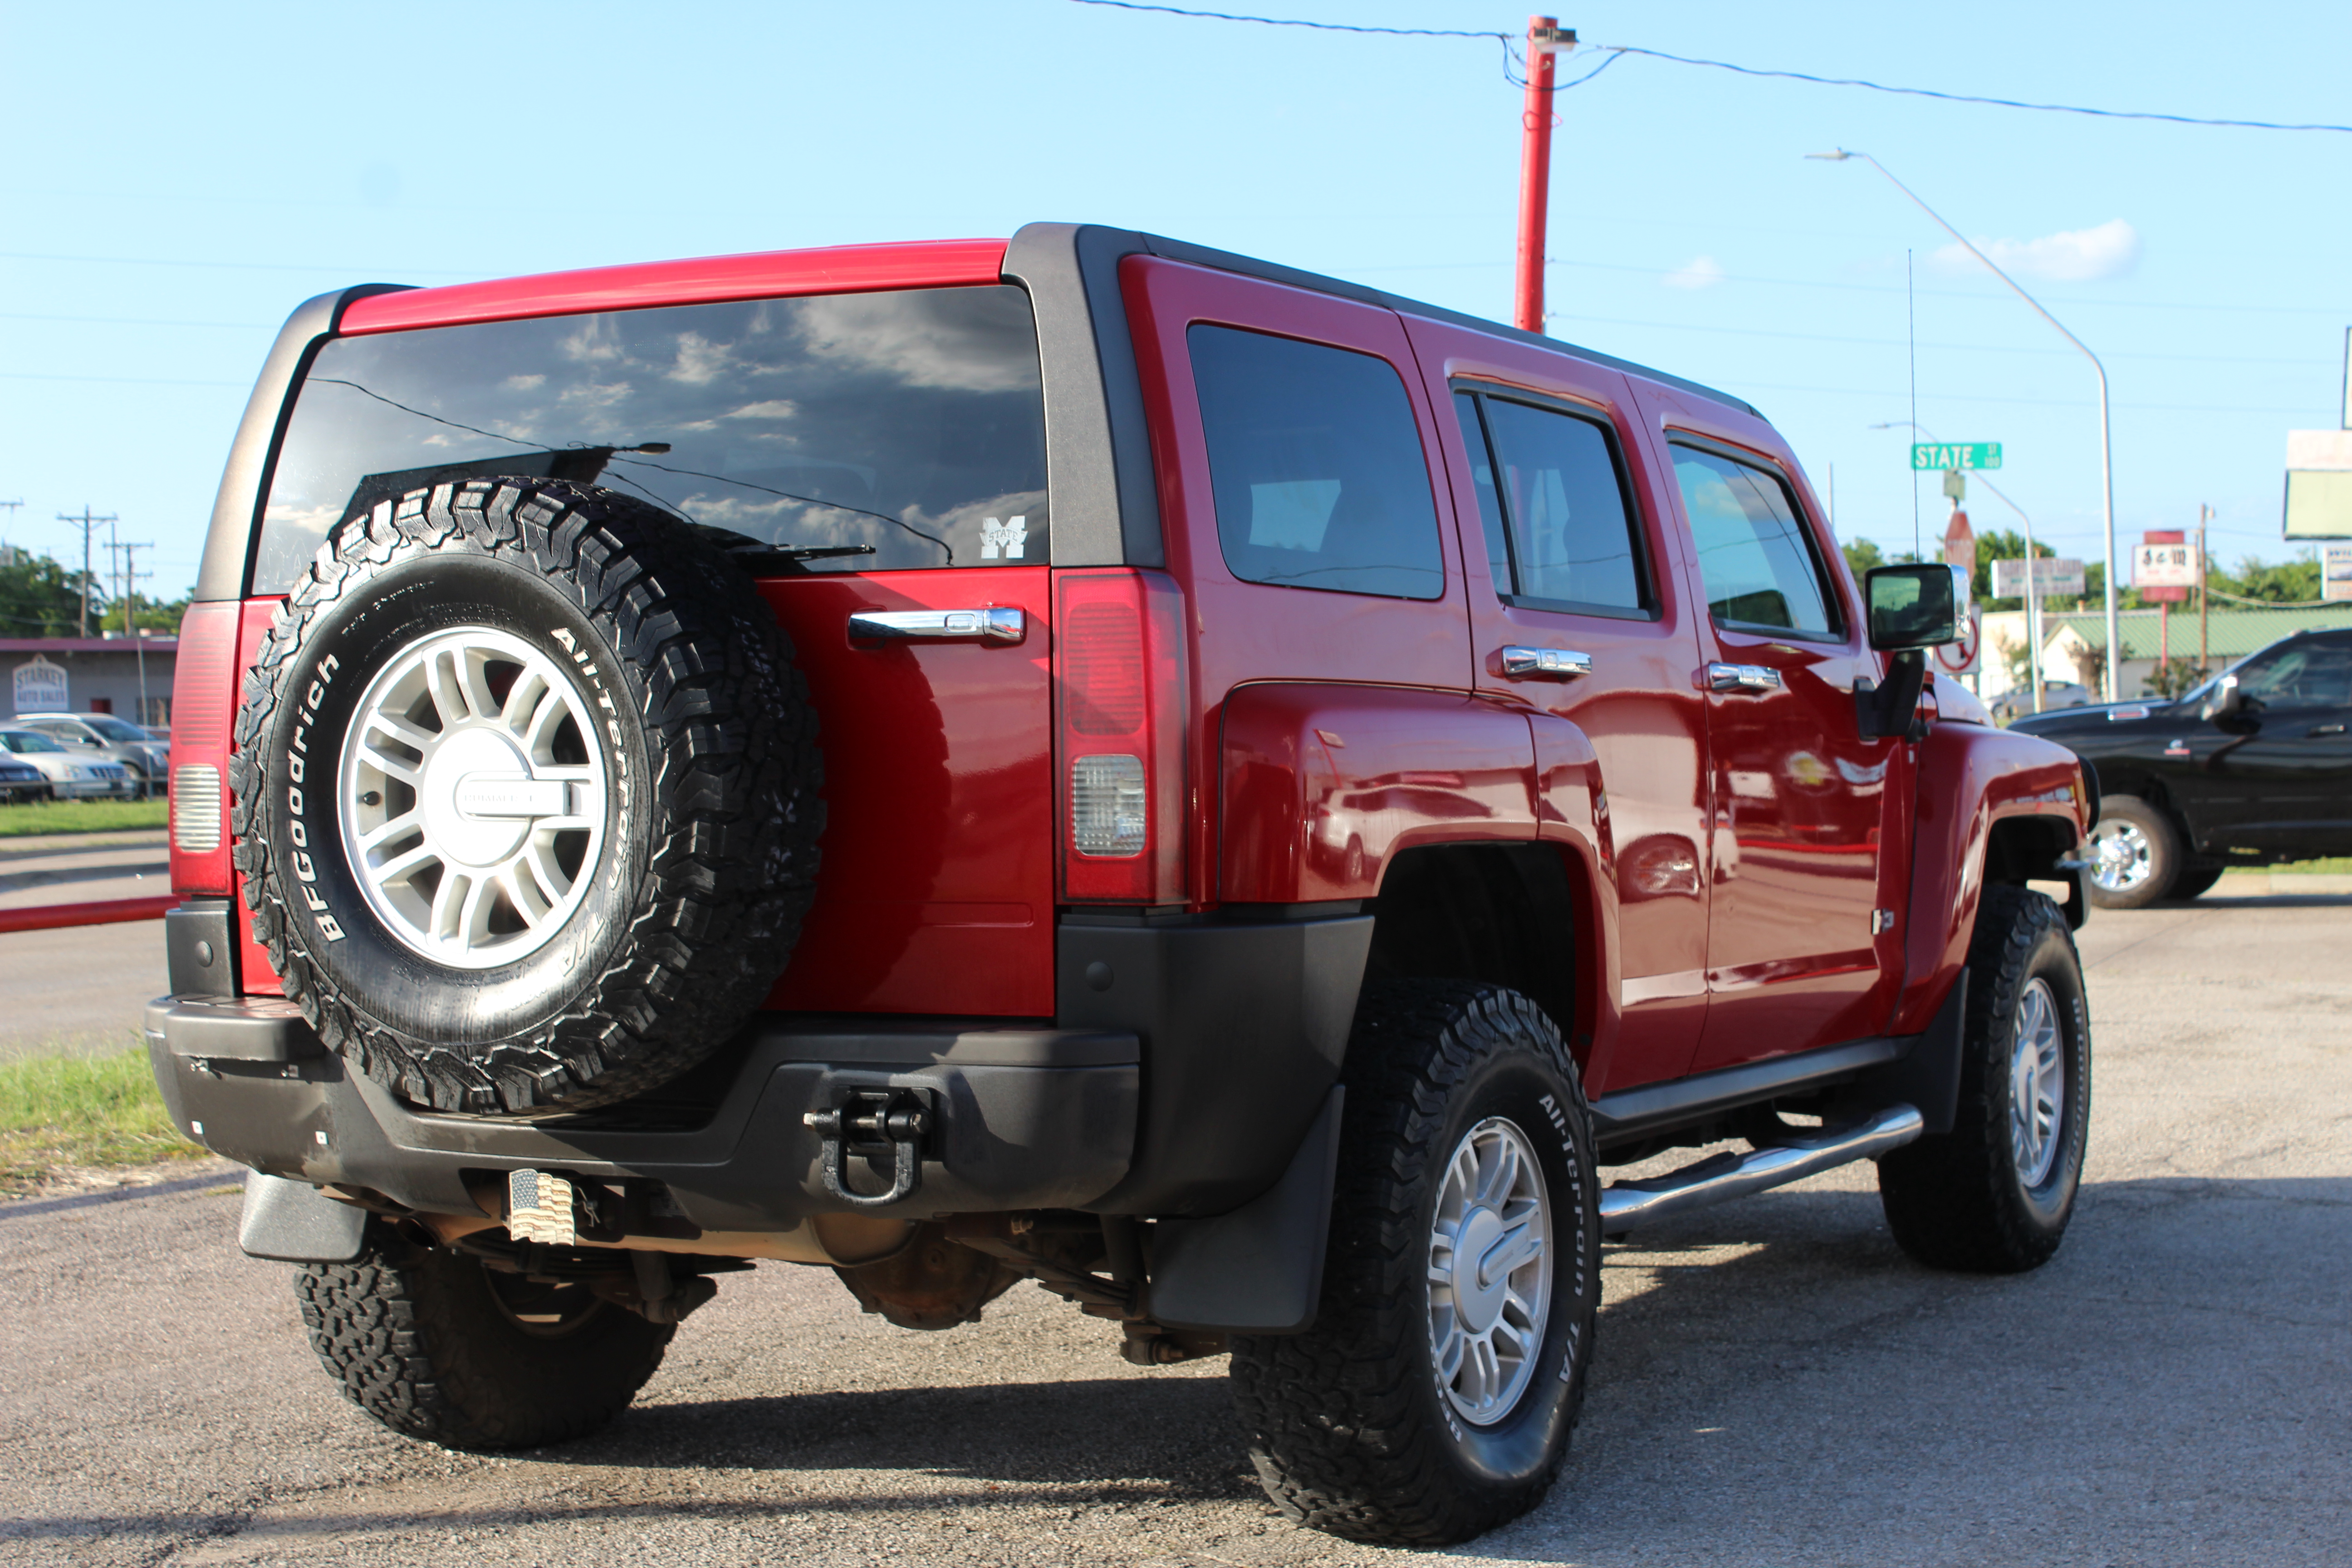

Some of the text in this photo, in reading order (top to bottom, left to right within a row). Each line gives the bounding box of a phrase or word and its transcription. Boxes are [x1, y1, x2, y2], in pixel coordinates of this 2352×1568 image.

[1915, 446, 1974, 468] STATE
[1987, 444, 1997, 455] ST
[989, 529, 1018, 543] STATE
[550, 627, 632, 890] All-Terrain
[288, 653, 347, 942] BFGoodrich
[558, 911, 605, 977] T/A
[1538, 1094, 1586, 1297] All-Terrain
[1558, 1322, 1581, 1383] T/A
